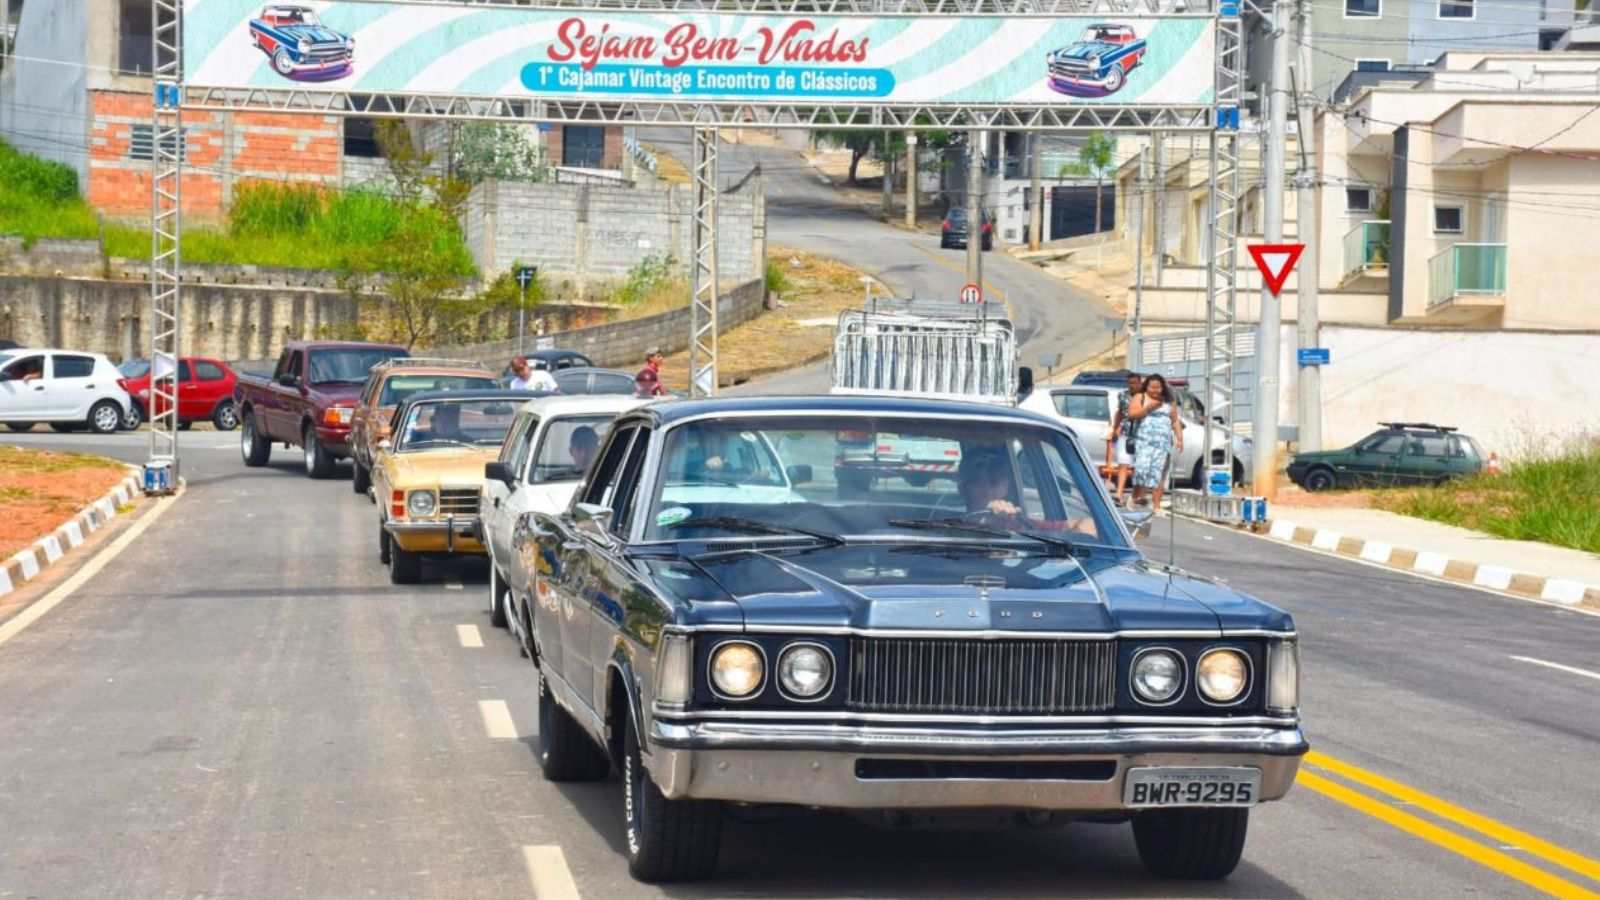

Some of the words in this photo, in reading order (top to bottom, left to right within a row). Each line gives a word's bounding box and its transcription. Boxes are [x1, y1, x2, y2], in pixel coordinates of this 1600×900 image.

[547, 17, 656, 70] Sejam
[662, 19, 870, 67] Bem-Vindos
[558, 66, 626, 91] Cajamar
[629, 68, 692, 94] Vintage
[697, 69, 770, 89] Encontro
[776, 69, 795, 89] de
[801, 70, 877, 91] Clássicos
